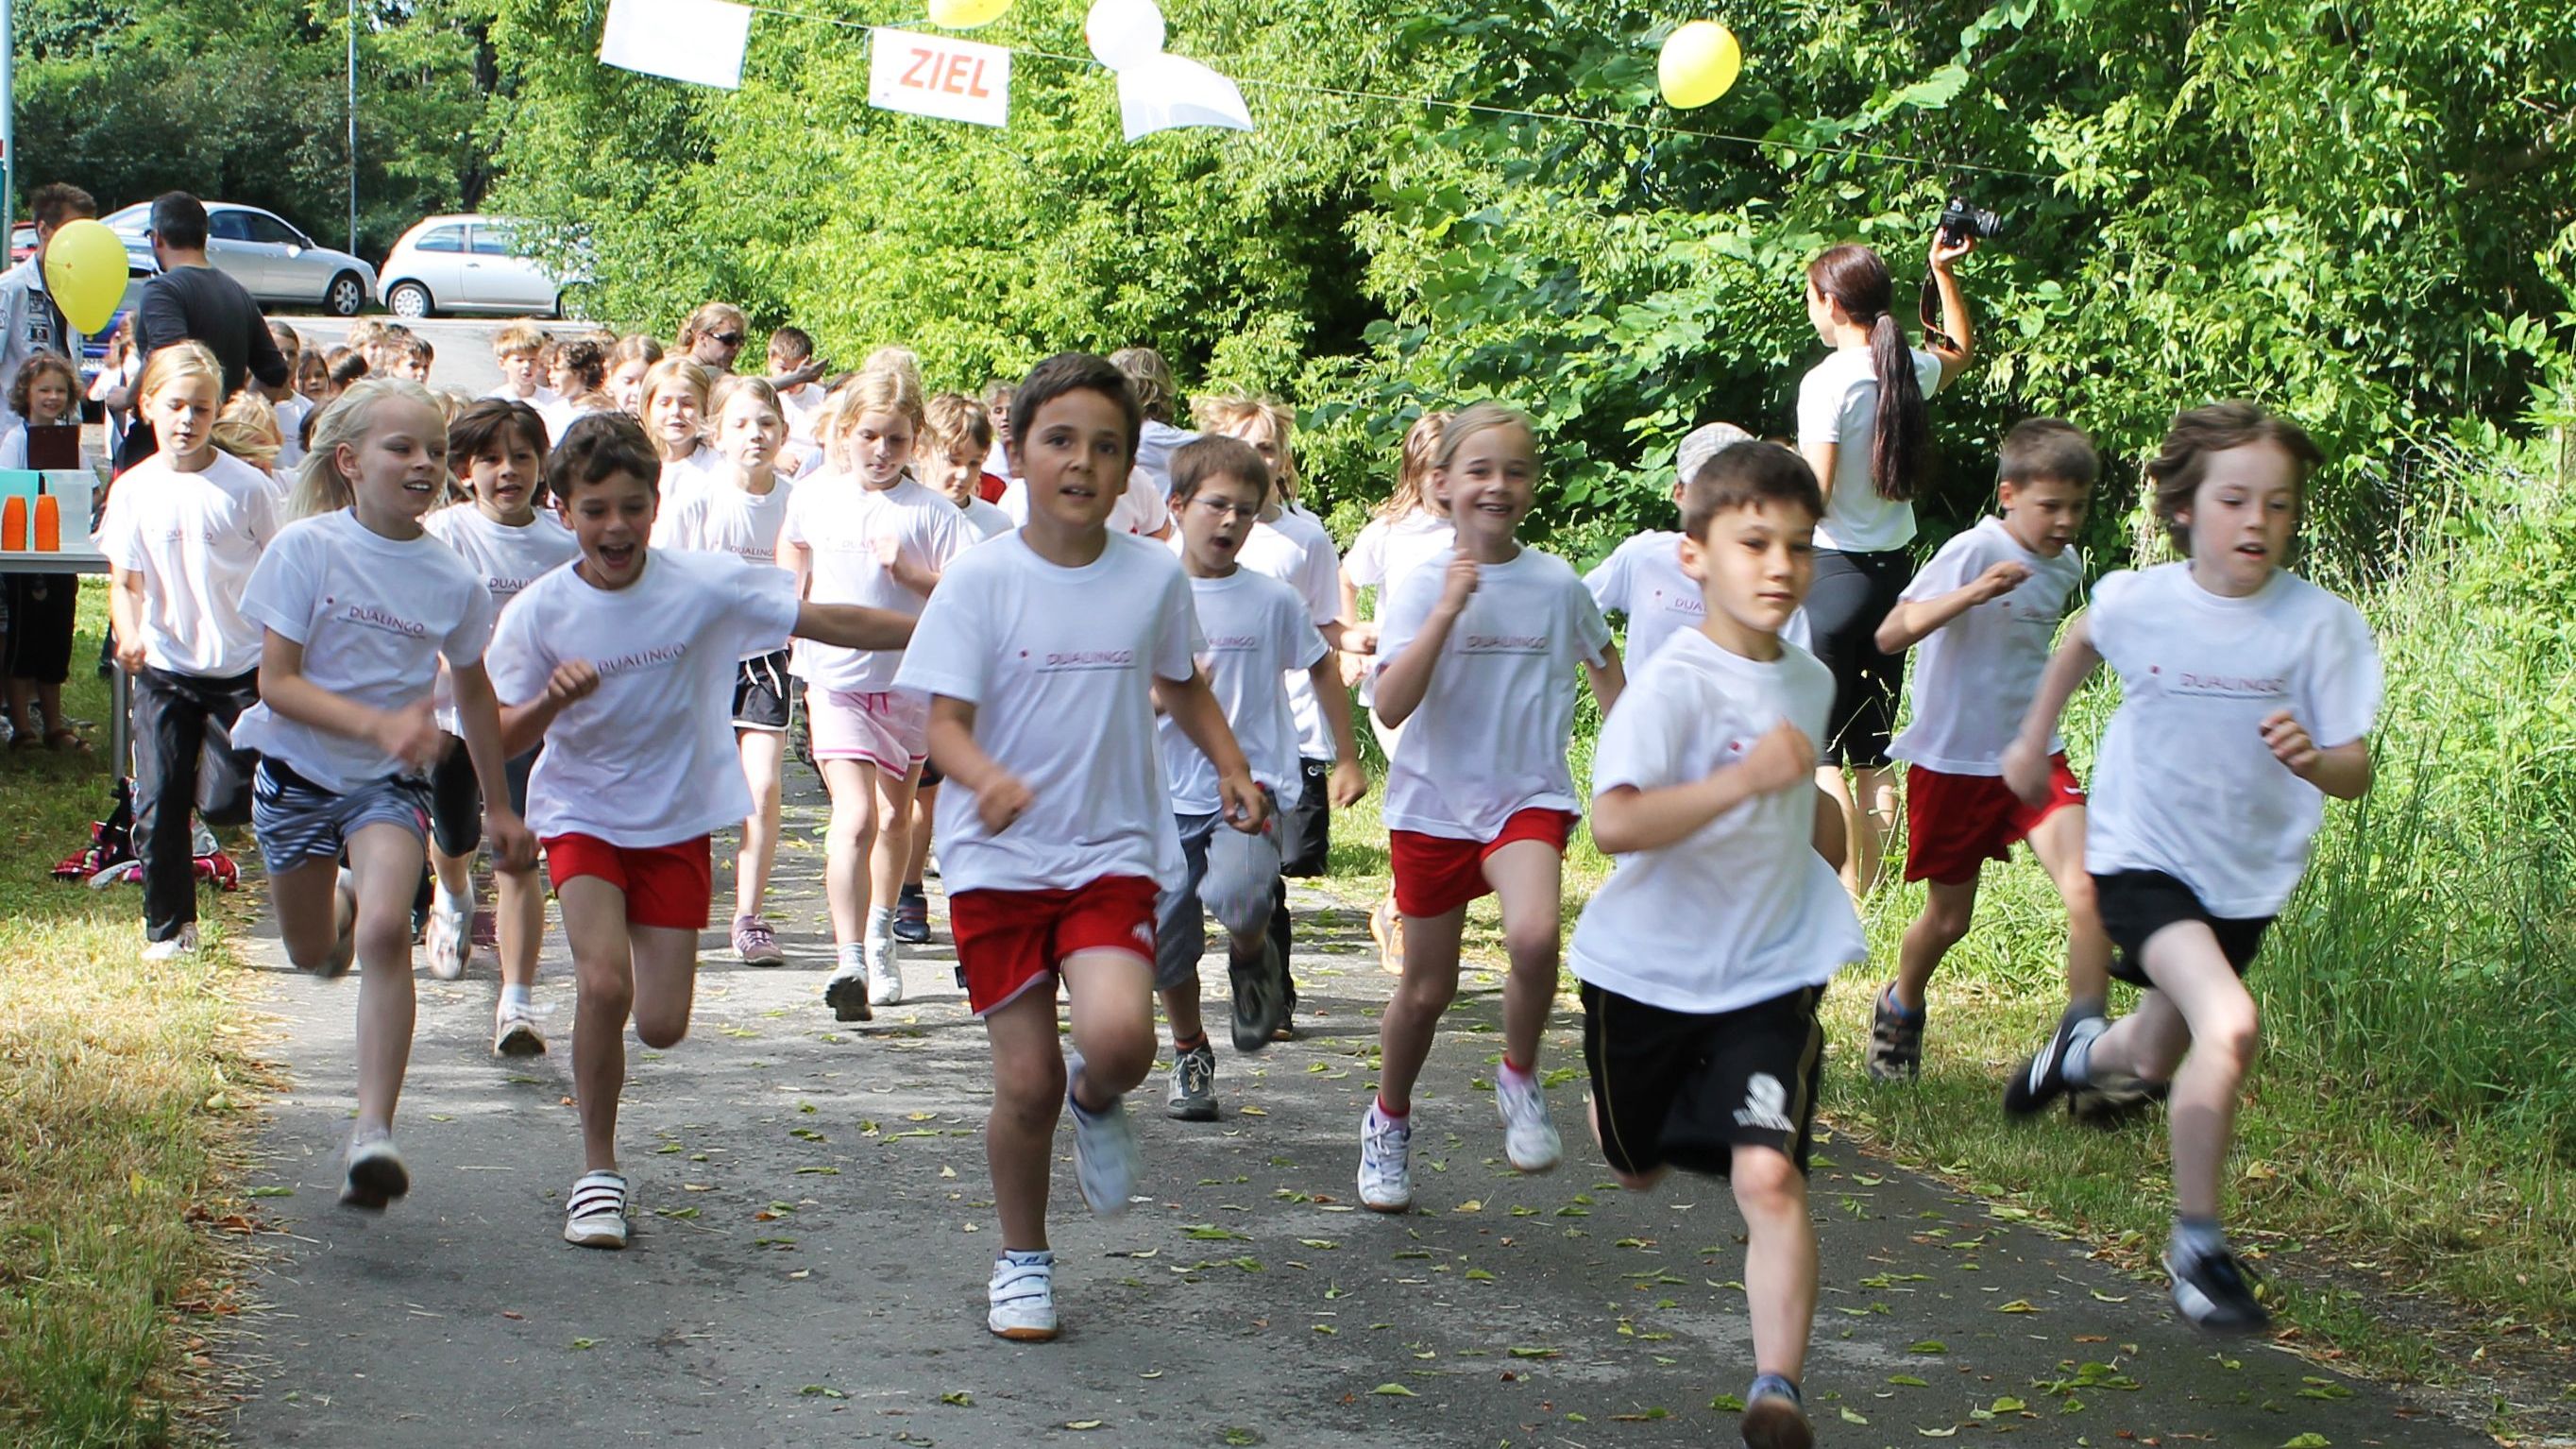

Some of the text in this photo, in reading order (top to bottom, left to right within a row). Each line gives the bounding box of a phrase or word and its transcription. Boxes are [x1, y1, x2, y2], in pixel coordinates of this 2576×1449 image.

[900, 47, 990, 98] ZIEL
[348, 605, 425, 634] DUALINGO
[1466, 635, 1548, 650] DUALINGO
[597, 642, 686, 673] DUALINGO
[1045, 649, 1133, 666] DUALINGO
